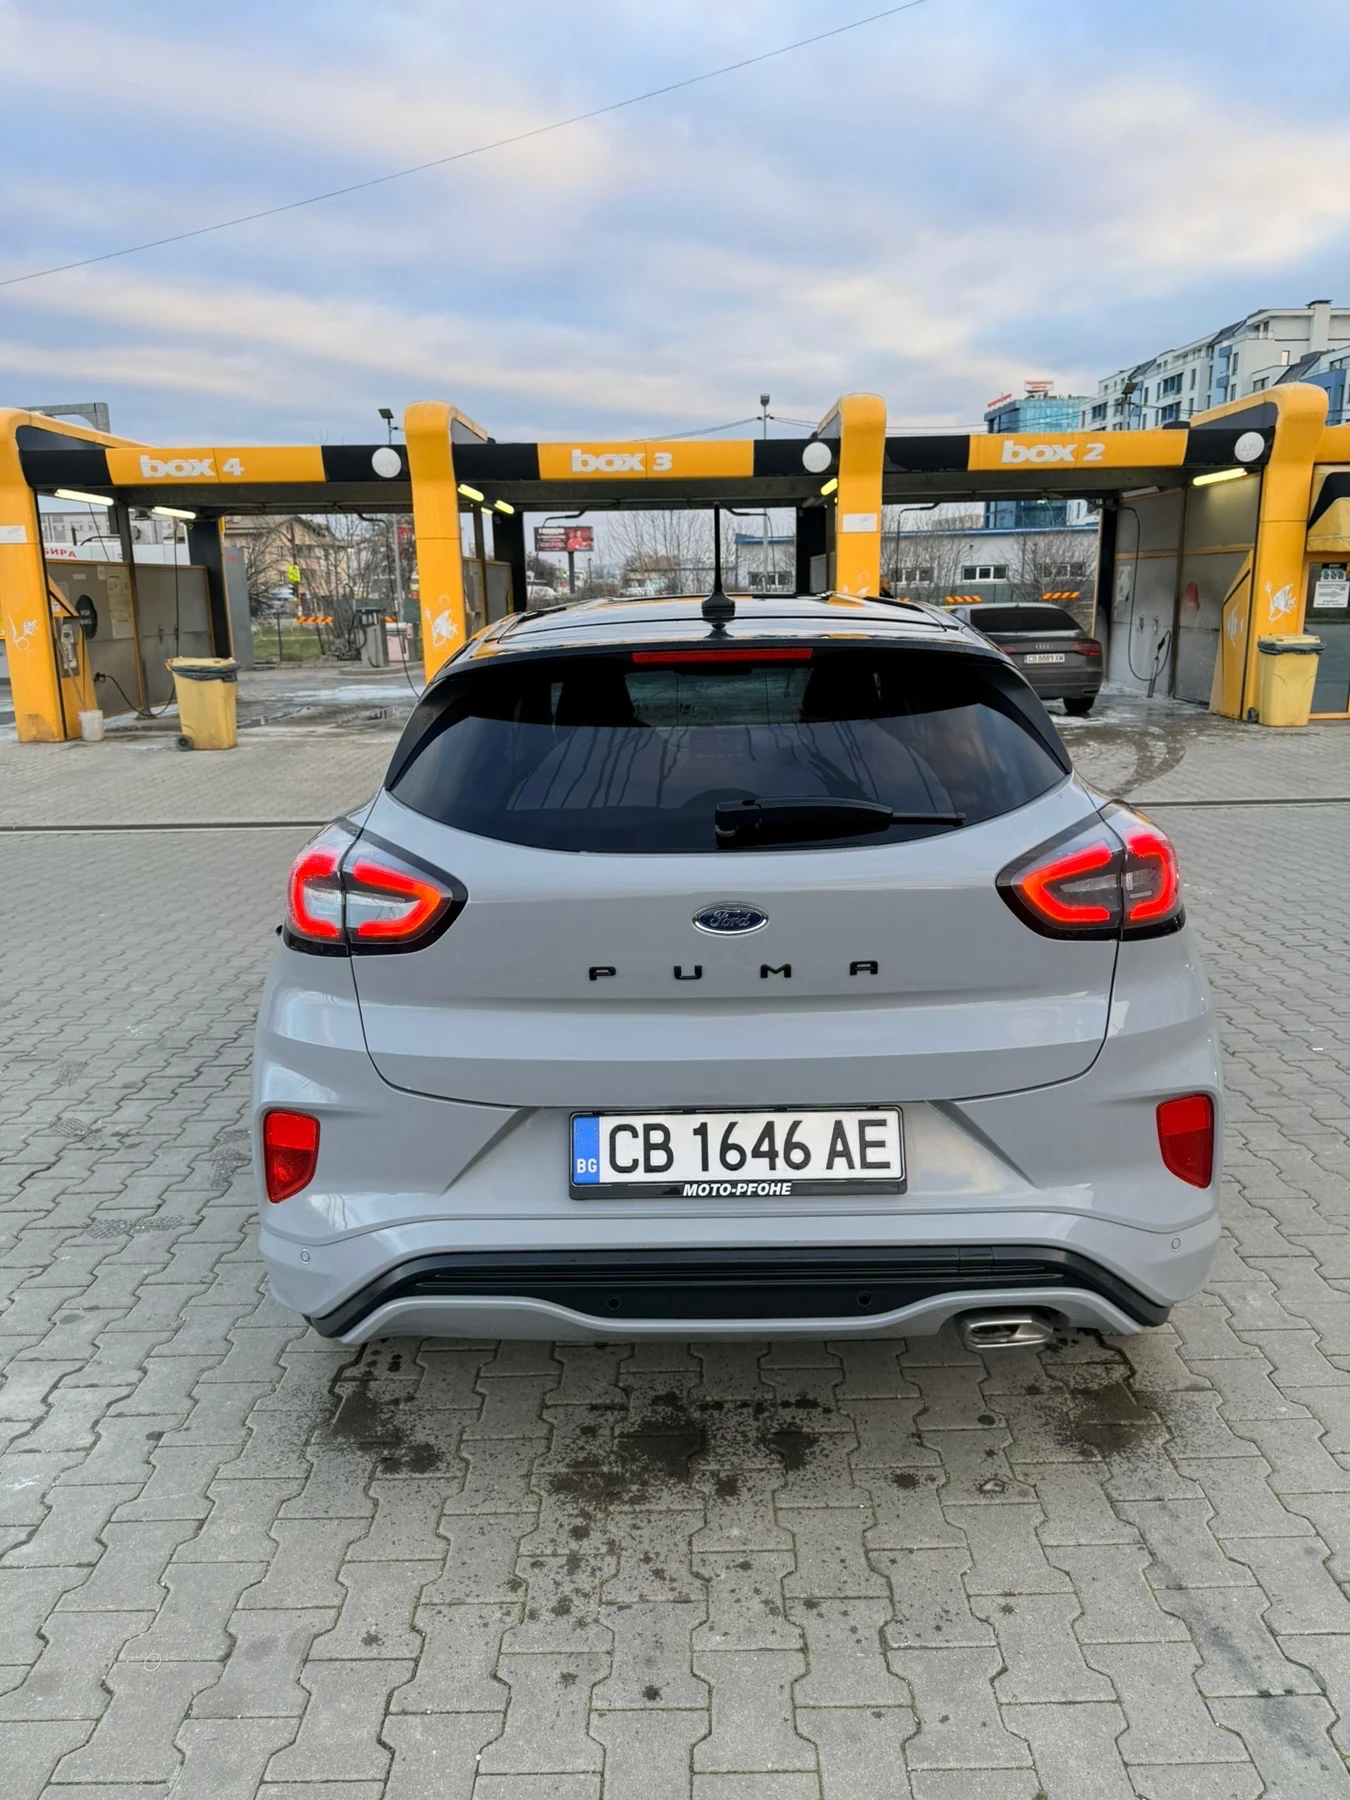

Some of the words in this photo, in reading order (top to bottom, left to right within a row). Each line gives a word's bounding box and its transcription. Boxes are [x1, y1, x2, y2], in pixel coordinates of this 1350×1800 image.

[571, 449, 645, 473] box
[653, 452, 673, 471] 3
[1001, 440, 1077, 464] box
[1083, 443, 1106, 462] 2
[139, 454, 216, 478] box
[222, 457, 245, 477] 4
[709, 908, 751, 930] Ford
[588, 959, 879, 981] PUMA
[608, 1123, 674, 1174] CB
[693, 1119, 812, 1172] 1646
[826, 1118, 891, 1171] AE
[576, 1159, 598, 1174] BG
[682, 1182, 792, 1198] MOTO-PFOHE
